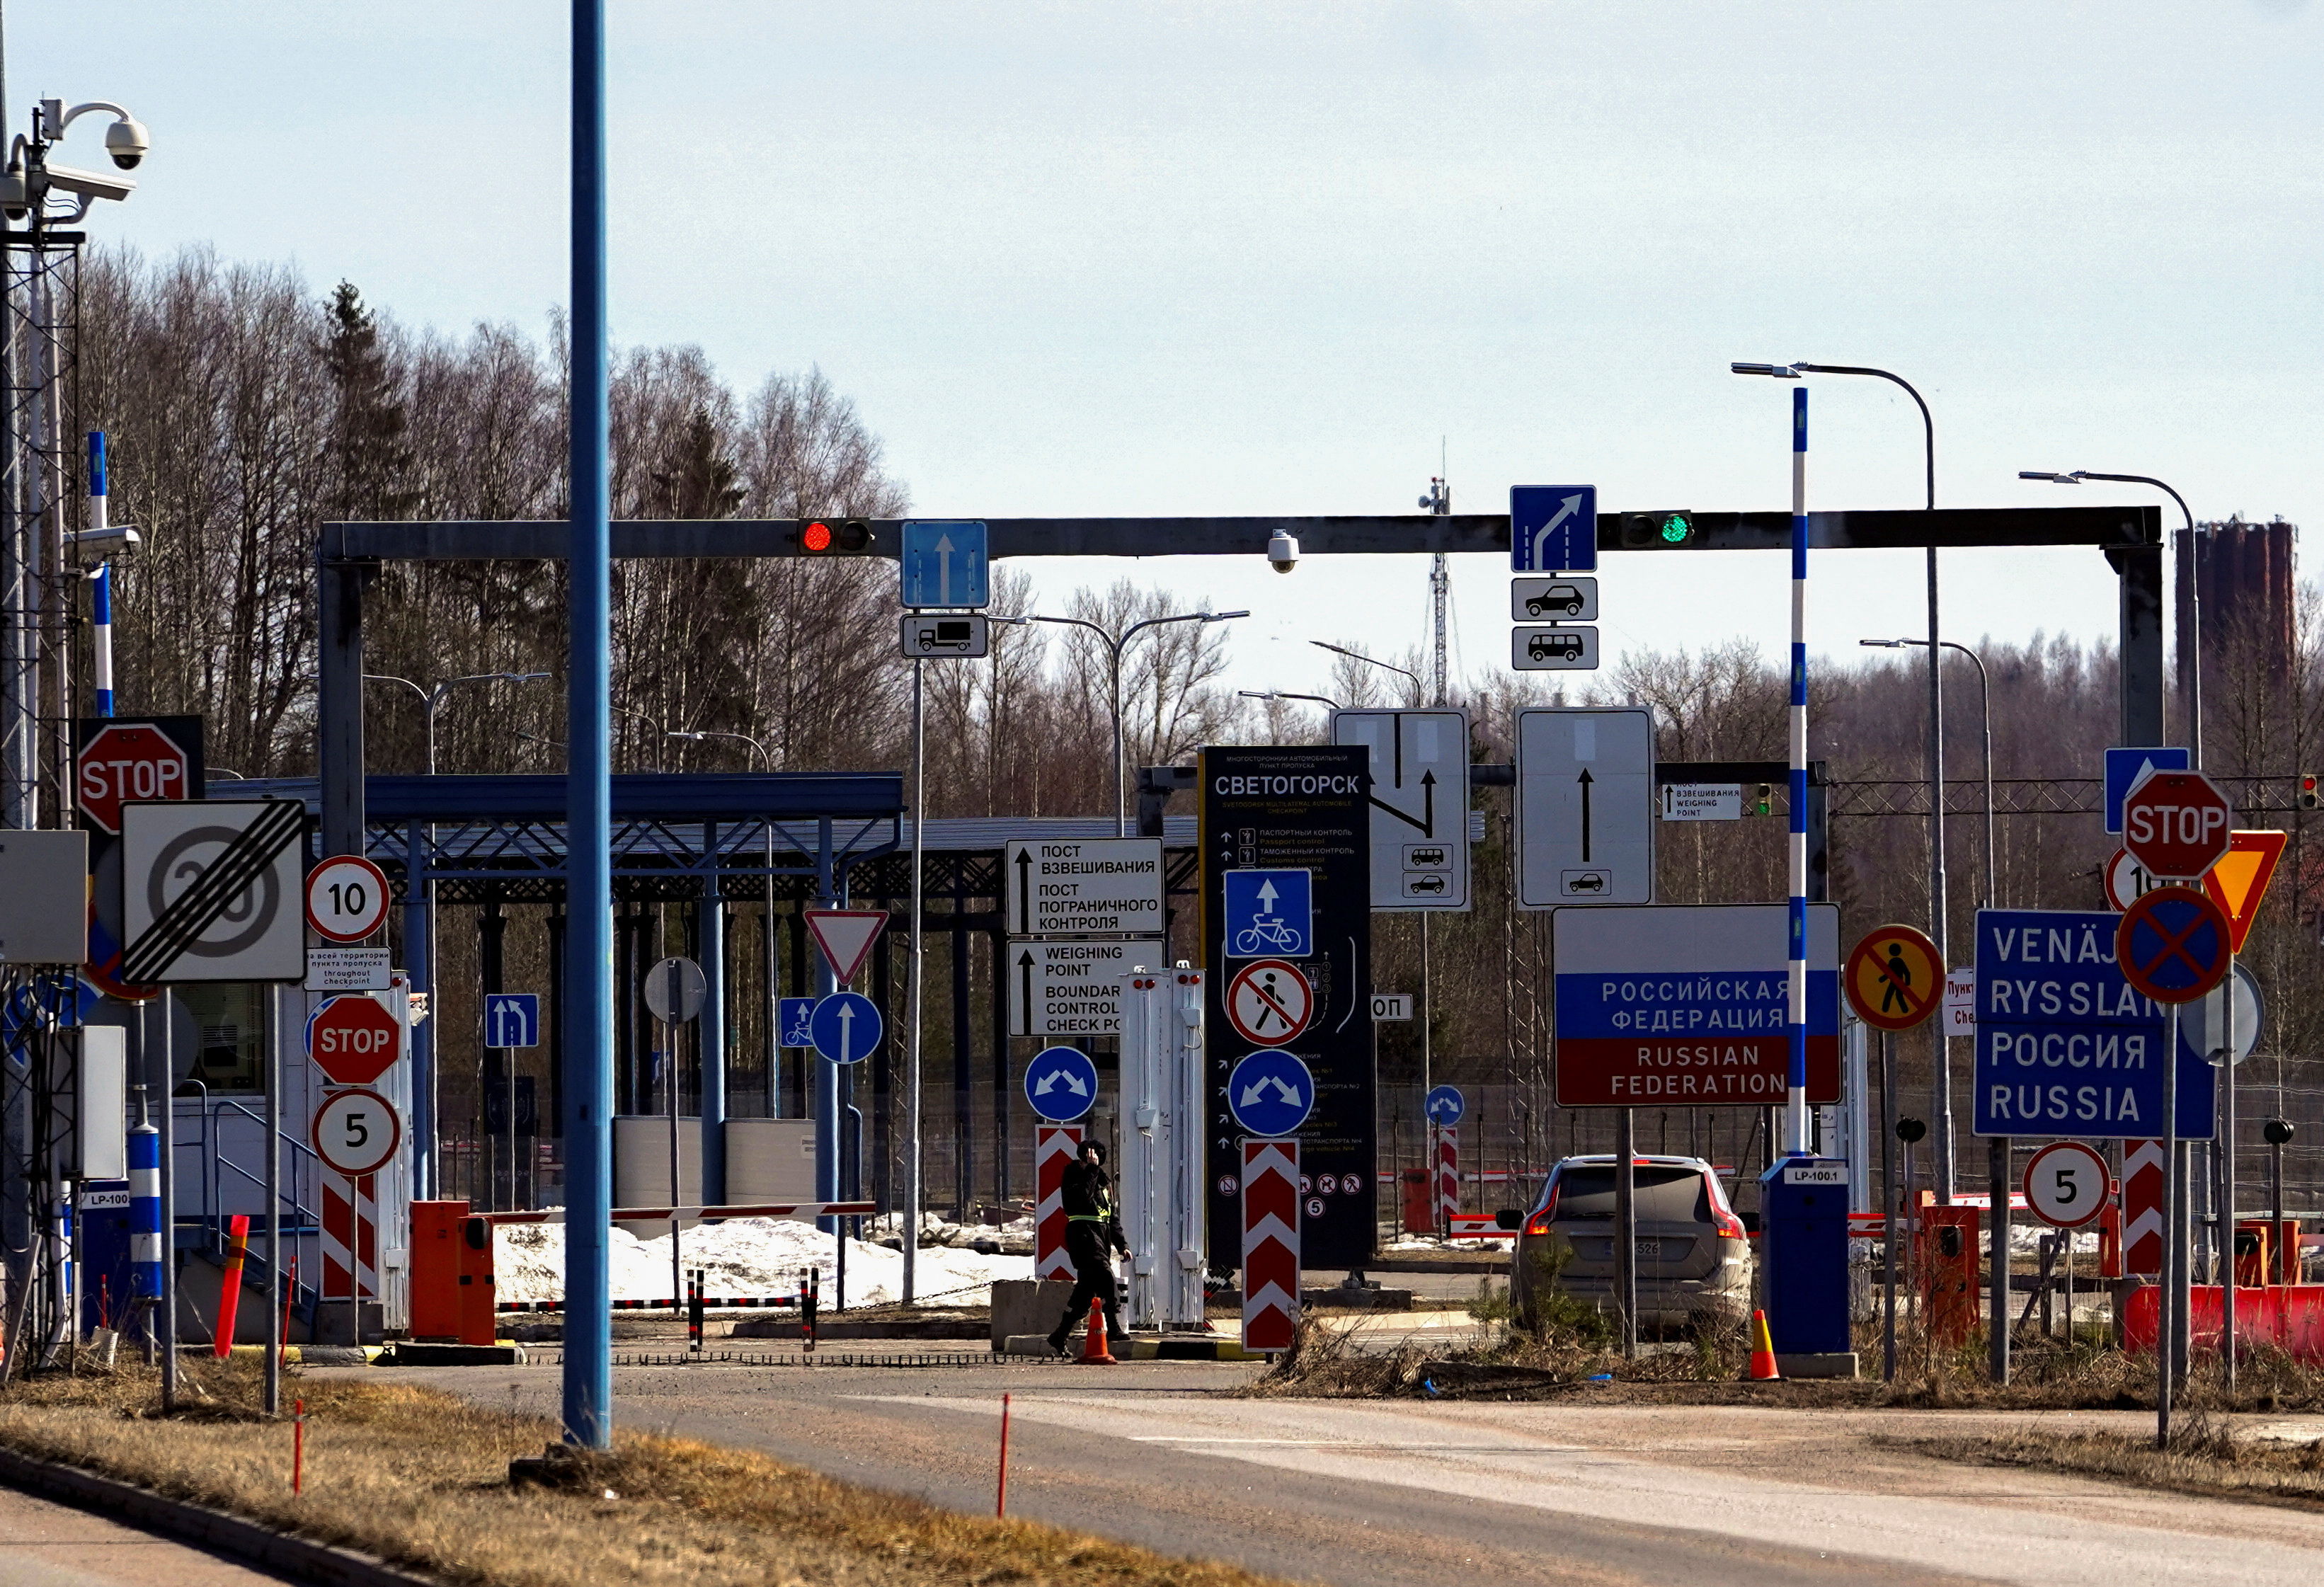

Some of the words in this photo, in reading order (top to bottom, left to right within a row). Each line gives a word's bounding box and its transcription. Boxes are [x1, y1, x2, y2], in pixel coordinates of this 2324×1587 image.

[82, 760, 180, 798] STOP
[1215, 776, 1359, 795] СВЕТОГОРСК
[2129, 806, 2224, 845] STOP
[1041, 845, 1081, 858] ПОСТ
[1041, 861, 1155, 875] ВЗВЕШИВАНИЯ
[328, 883, 366, 916] 10
[1039, 884, 1079, 897] ПОСТ
[1038, 899, 1158, 914] ПОГРАНИЧНОГО
[1039, 916, 1118, 930] КОНТРОЛЯ
[1046, 946, 1123, 959] WEIGHING
[1993, 923, 2118, 964] VENÄJ
[340, 952, 389, 961] территории
[1046, 963, 1091, 976] POINT
[1046, 985, 1121, 998] BOUNDAR
[1602, 977, 1789, 1002] РОССИЙСКАЯ
[1991, 979, 2166, 1018] RYSSLAN
[1046, 1002, 1120, 1014] CONTROL
[1373, 999, 1400, 1016] ОП
[1046, 1019, 1099, 1031] CHECK
[1611, 1008, 1783, 1032] ФЕДЕРАЦИЯ
[321, 1026, 389, 1055] STOP
[1637, 1045, 1758, 1067] RUSSIAN
[1991, 1031, 2146, 1070] РОССИЯ
[1611, 1074, 1785, 1095] FEDERATION
[1990, 1084, 2141, 1122] RUSSIA
[345, 1113, 368, 1147] 5
[1794, 1171, 1838, 1181] LP-100.1
[2055, 1170, 2077, 1204] 5
[1312, 1201, 1320, 1214] 5
[1637, 1244, 1658, 1254] 526
